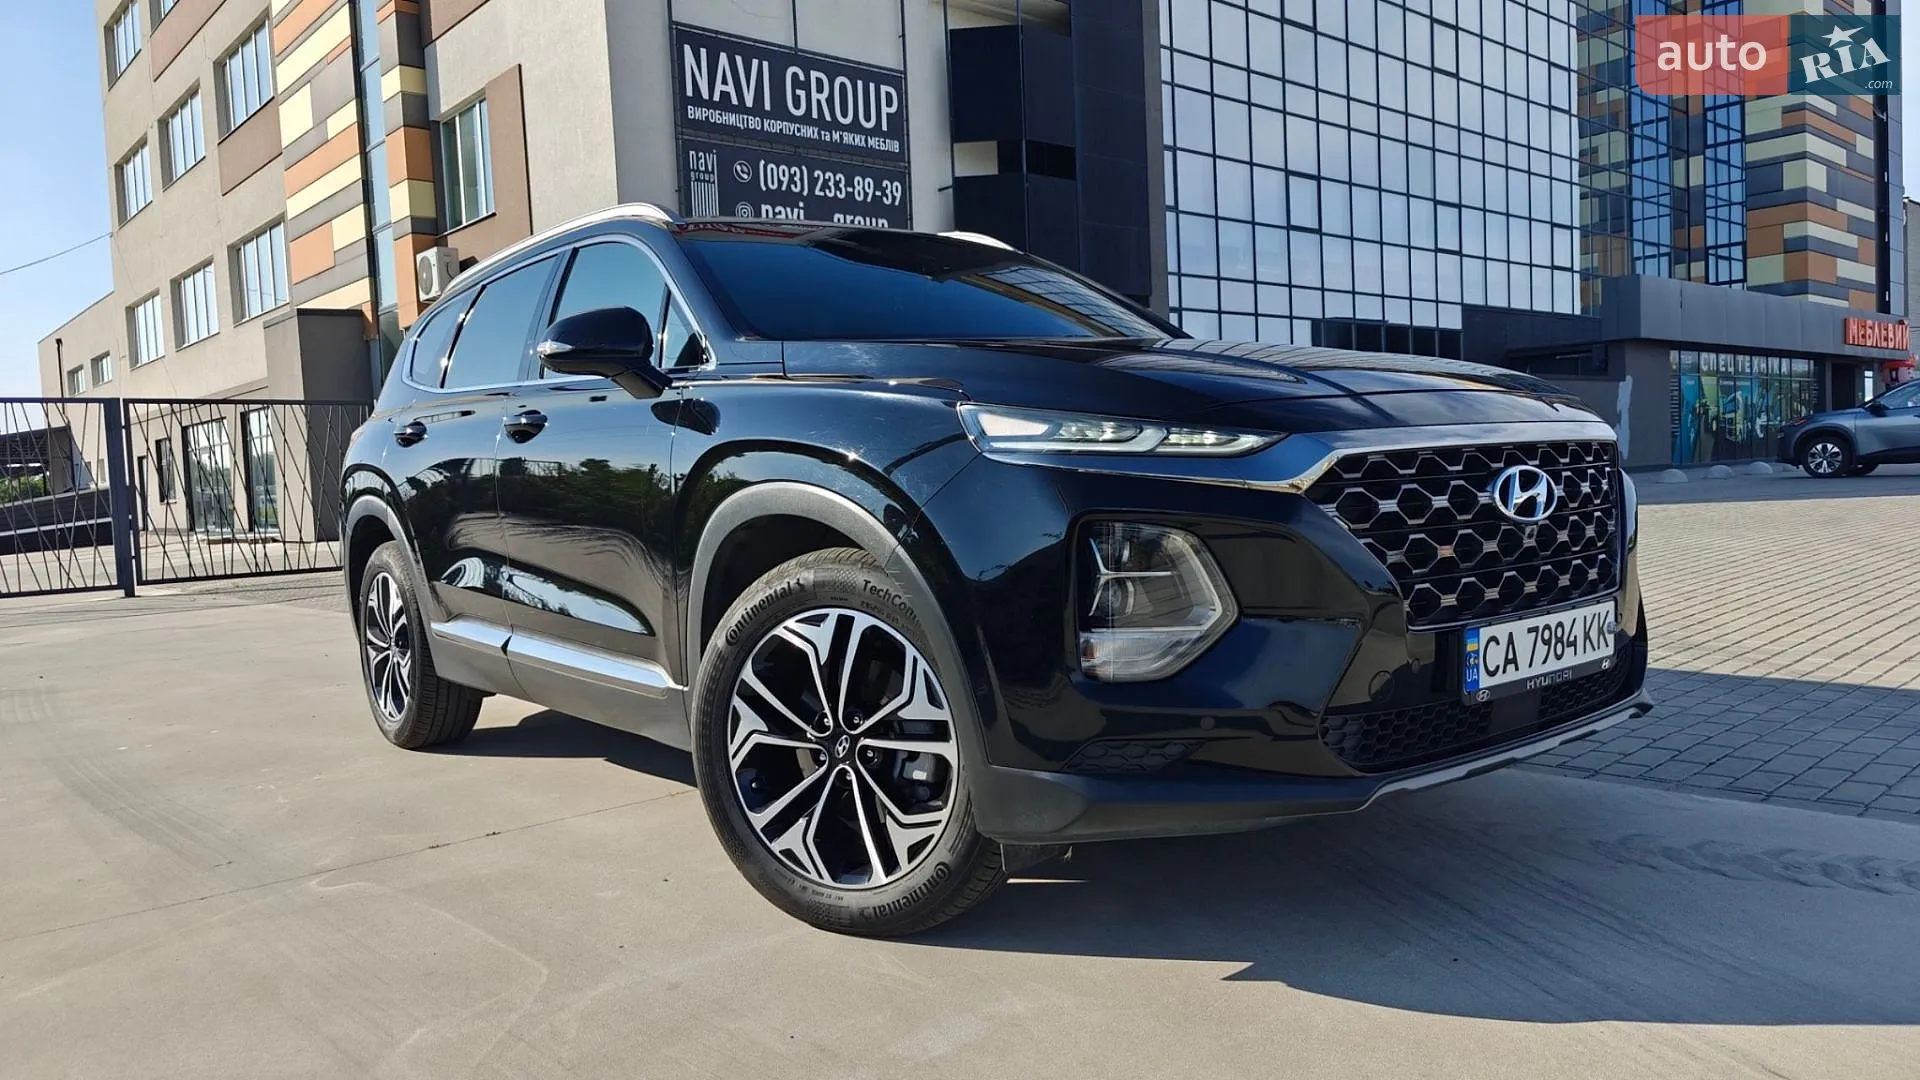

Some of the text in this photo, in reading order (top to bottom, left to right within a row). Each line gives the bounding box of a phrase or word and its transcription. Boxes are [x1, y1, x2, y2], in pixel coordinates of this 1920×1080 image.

[683, 43, 899, 131] NAVI GROUP
[687, 105, 900, 153] ВИРОБНИЦТВО КОРПУСНИХ та М'ЯКИХ МЕБЛІВ
[689, 149, 717, 172] navi
[690, 171, 715, 182] group
[759, 159, 902, 206] (093) 233-89-39
[1846, 317, 1911, 351] МЕБЛЕВИЙ
[725, 581, 793, 646] Continental
[1482, 610, 1610, 678] CA 7984 KK
[1466, 667, 1478, 682] UA
[1526, 670, 1573, 690] HYUNDAI
[871, 861, 951, 917] Continental
